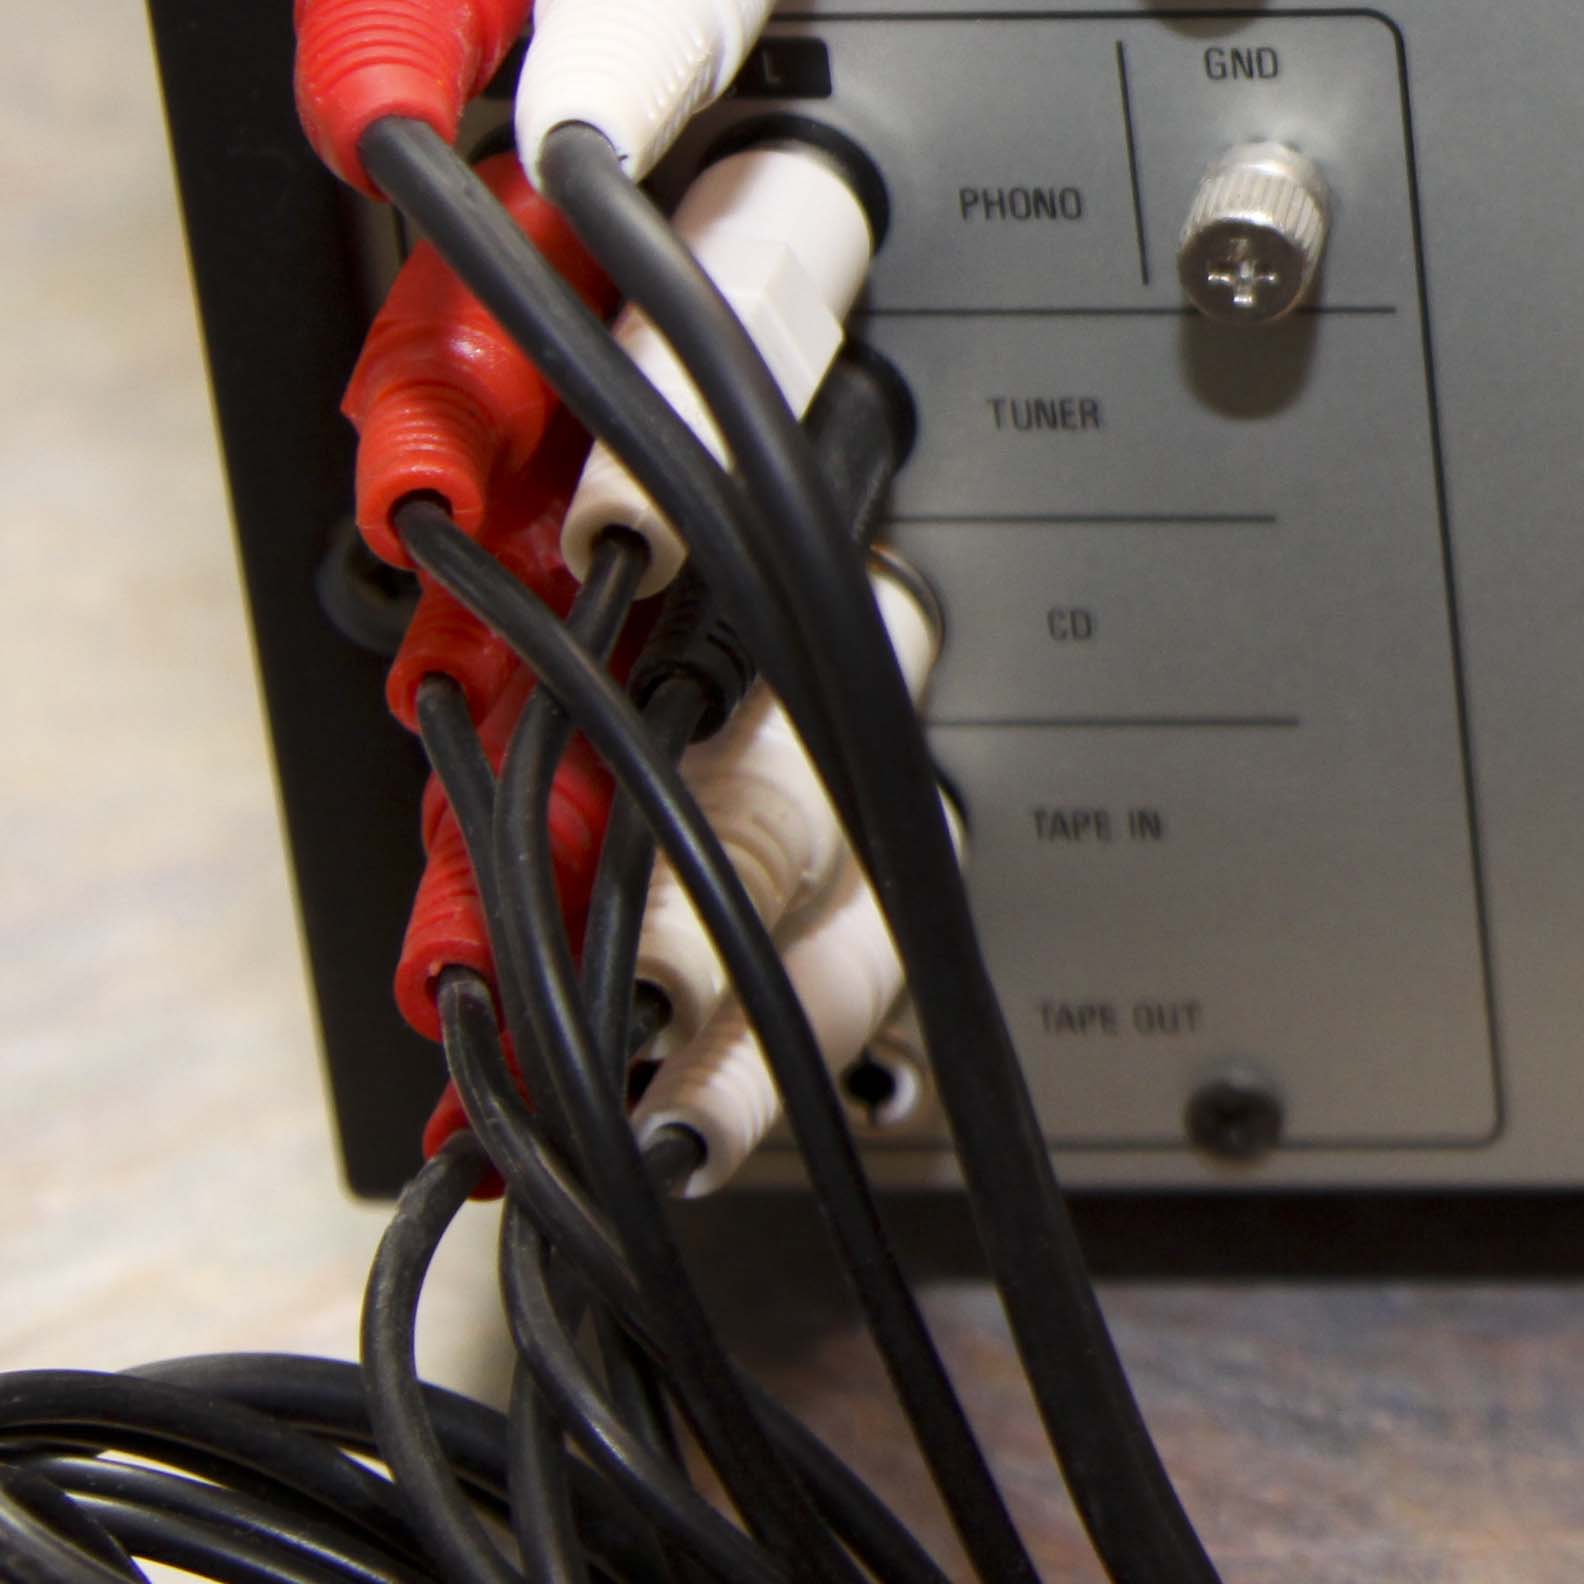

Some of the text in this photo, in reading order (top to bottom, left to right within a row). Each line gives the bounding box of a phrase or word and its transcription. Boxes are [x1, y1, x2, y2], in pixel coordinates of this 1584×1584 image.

[762, 52, 781, 84] L
[1204, 47, 1278, 80] GND
[960, 188, 1082, 220] PHONO
[988, 398, 1102, 431] TUNER
[1048, 608, 1094, 640] CD
[1031, 809, 1163, 840] TAPE IN
[1039, 1003, 1200, 1033] TAPE OUT
